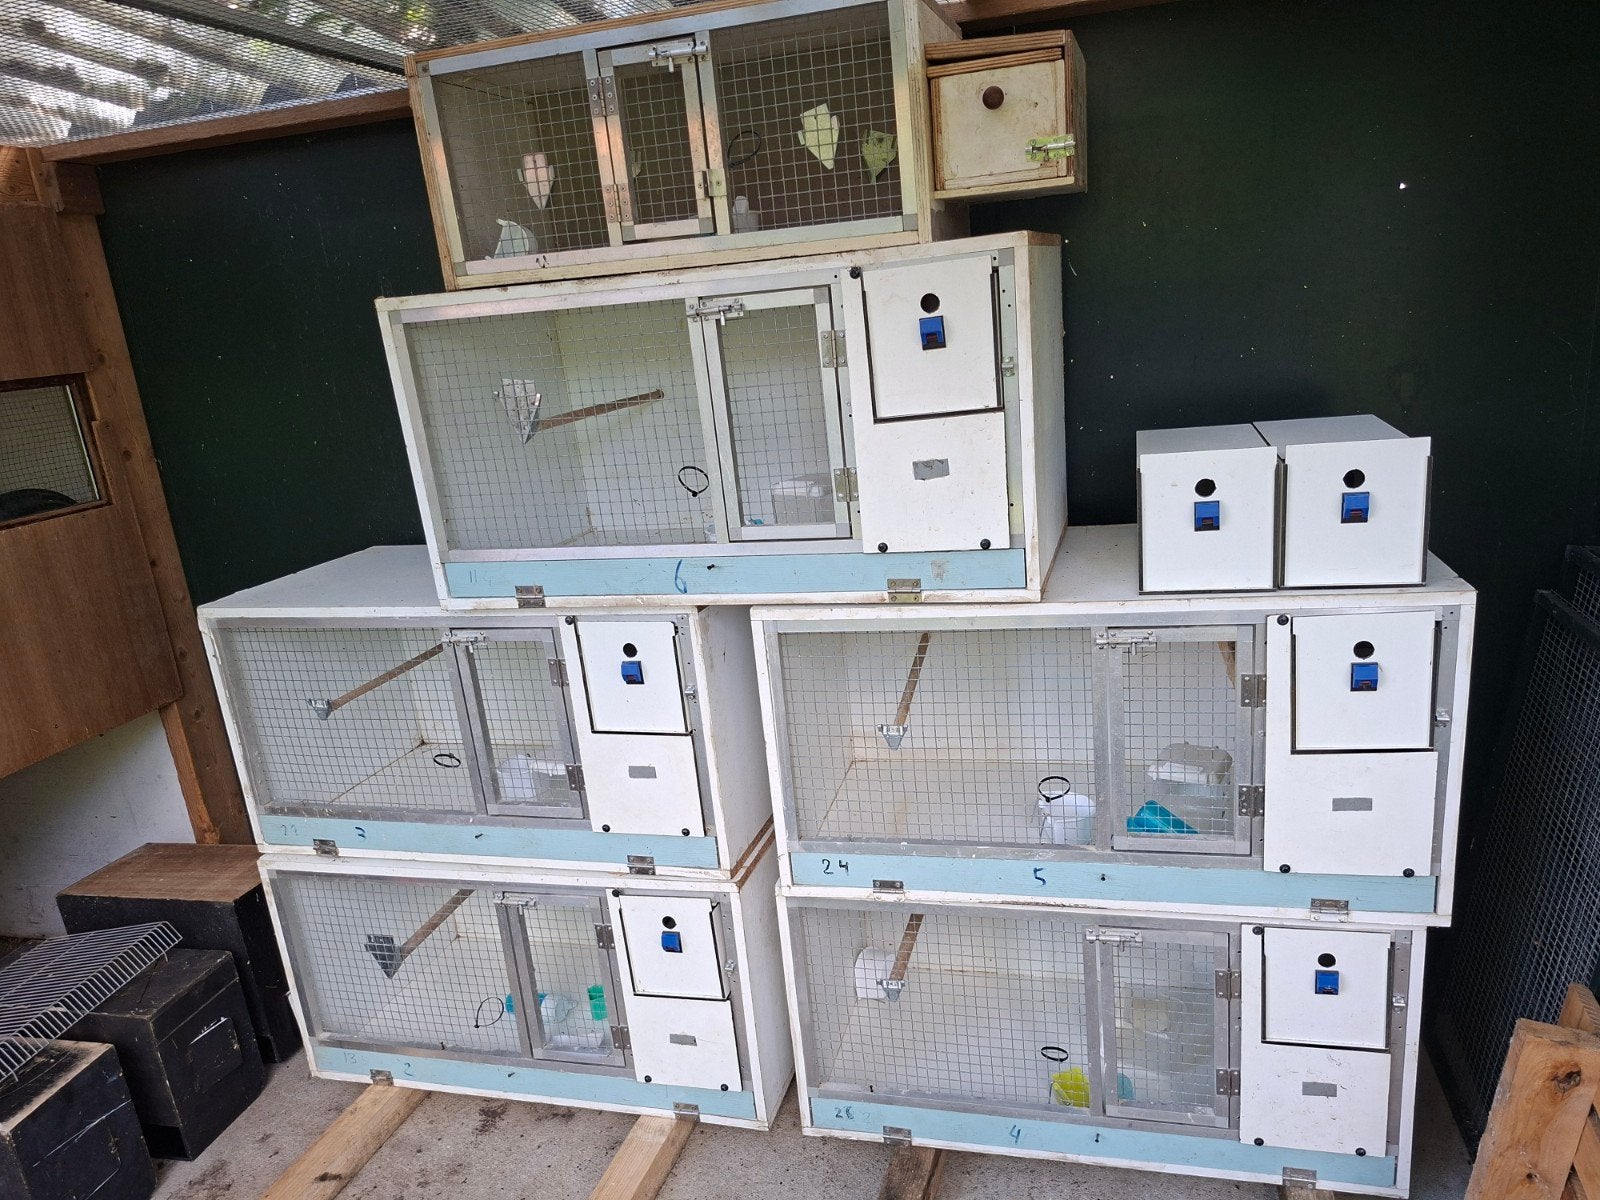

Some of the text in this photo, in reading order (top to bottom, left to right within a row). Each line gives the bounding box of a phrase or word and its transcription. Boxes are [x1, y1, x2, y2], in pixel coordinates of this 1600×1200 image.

[674, 559, 688, 594] 6
[821, 858, 849, 876] 24
[1033, 867, 1047, 886] 5
[403, 1062, 414, 1077] 2
[1009, 1124, 1021, 1145] 4
